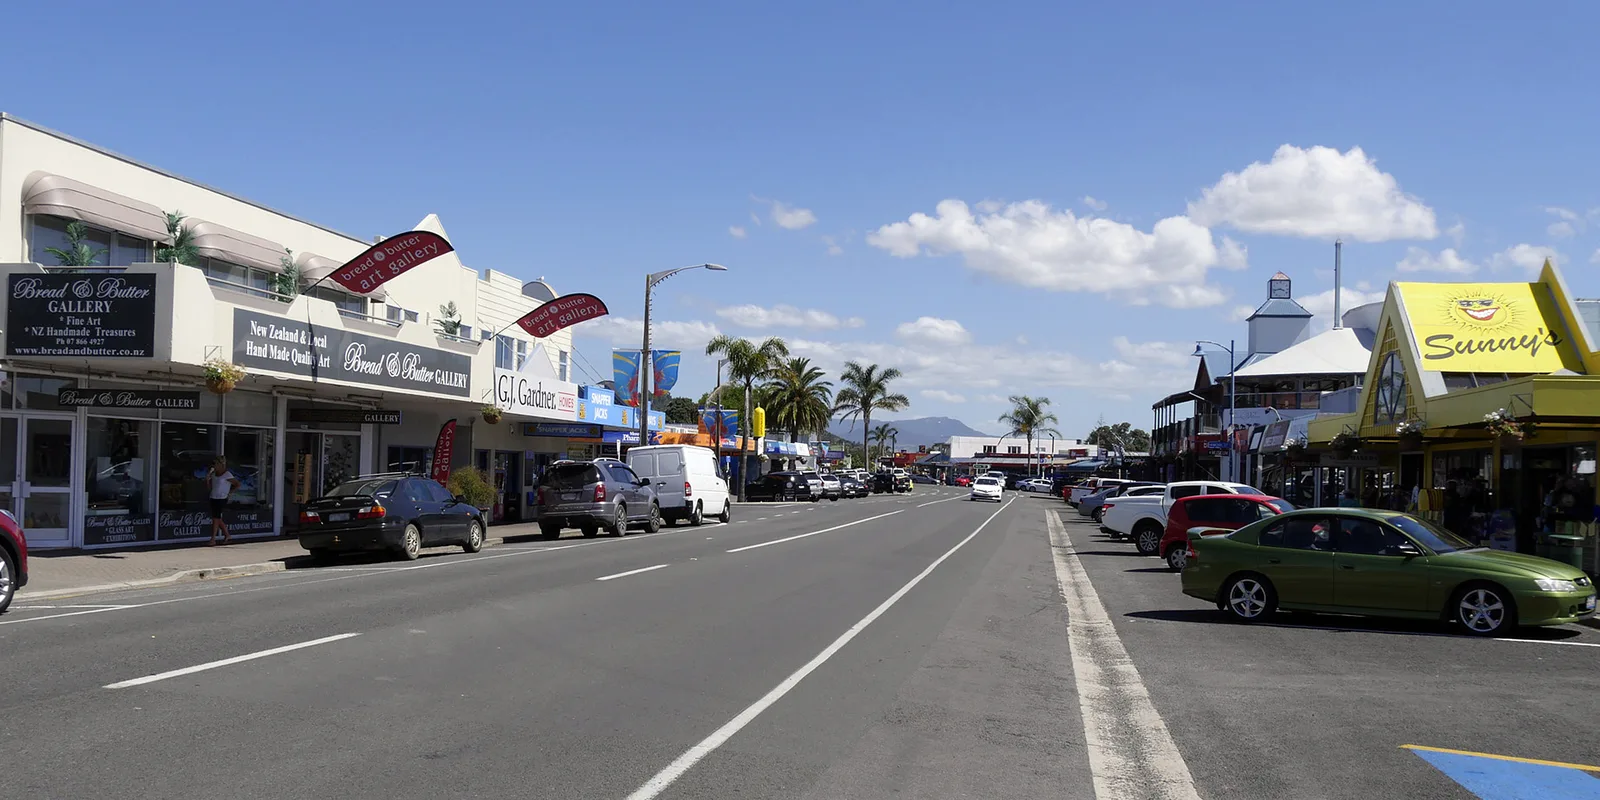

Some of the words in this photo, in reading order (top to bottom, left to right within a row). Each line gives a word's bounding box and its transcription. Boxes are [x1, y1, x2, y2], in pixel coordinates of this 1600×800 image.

[341, 258, 375, 281] bread
[384, 235, 420, 256] butter
[360, 269, 384, 290] art
[388, 242, 439, 275] gallery
[13, 277, 70, 299] Bread
[72, 278, 94, 298] &
[96, 277, 150, 299] Butter
[48, 300, 113, 313] GALLERY
[525, 310, 549, 328] bread
[558, 297, 587, 310] butter
[537, 320, 555, 335] art
[559, 304, 598, 326] gallery
[31, 327, 45, 337] NZ
[46, 327, 91, 337] Handmade
[95, 327, 136, 337] Treasures
[66, 316, 85, 326] Fine
[86, 316, 101, 326] Art
[250, 320, 268, 338] New
[269, 323, 299, 344] Zealand
[300, 330, 307, 345] &
[15, 346, 145, 356] www.breadandbutter.co.nz
[246, 340, 268, 358] Hand
[269, 344, 290, 362] Made
[318, 353, 331, 368] Art
[1424, 328, 1563, 360] Sunny's
[343, 342, 385, 376] Bread
[401, 352, 436, 383] Butter
[435, 369, 468, 389] GALLERY
[60, 390, 97, 405] Bread
[116, 391, 151, 407] Butter
[155, 398, 195, 408] GALLERY
[498, 374, 516, 410] G.J.
[364, 414, 399, 422] GALLERY
